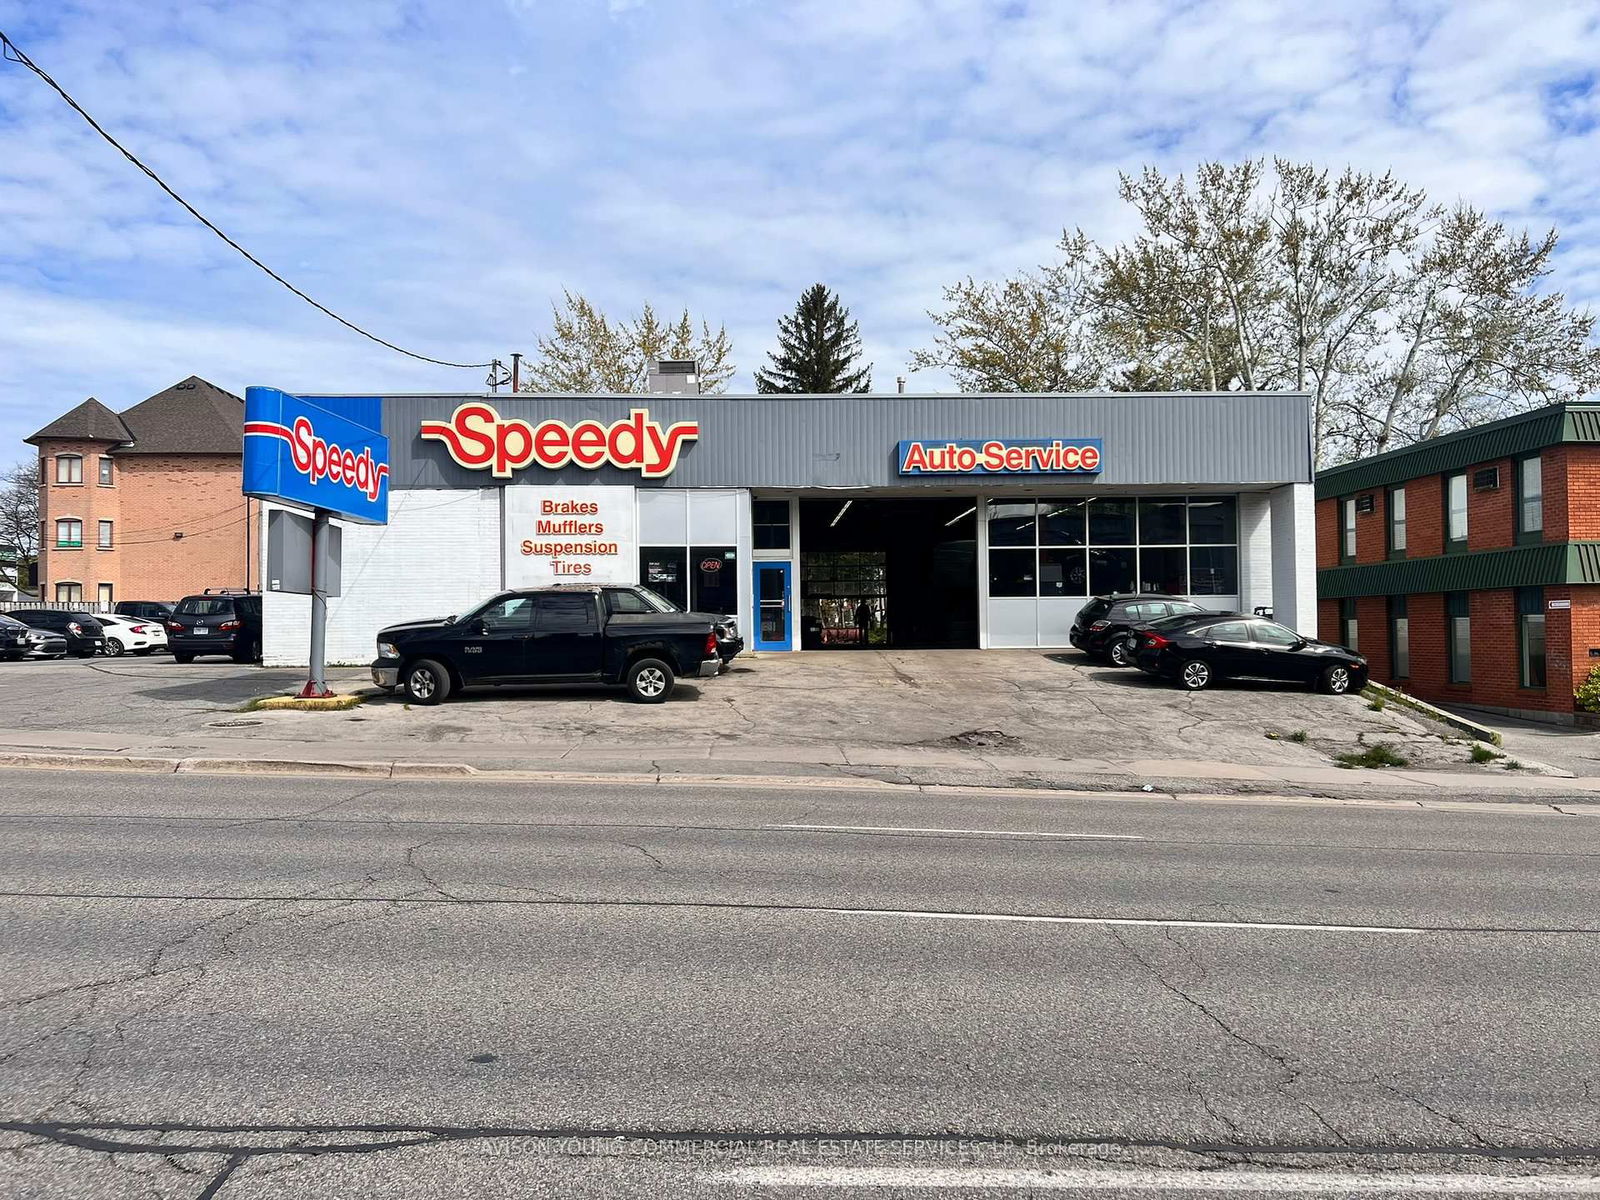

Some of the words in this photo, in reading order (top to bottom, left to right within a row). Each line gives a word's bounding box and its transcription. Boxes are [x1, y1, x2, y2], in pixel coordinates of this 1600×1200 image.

[423, 404, 696, 475] Speedy
[284, 416, 389, 502] Speedy
[902, 442, 977, 471] Auto
[981, 441, 1101, 471] Service
[541, 499, 599, 515] Brakes
[536, 519, 604, 535] Mufflers
[521, 539, 618, 558] Suspension
[550, 560, 592, 576] Tires
[703, 561, 720, 569] OPEN
